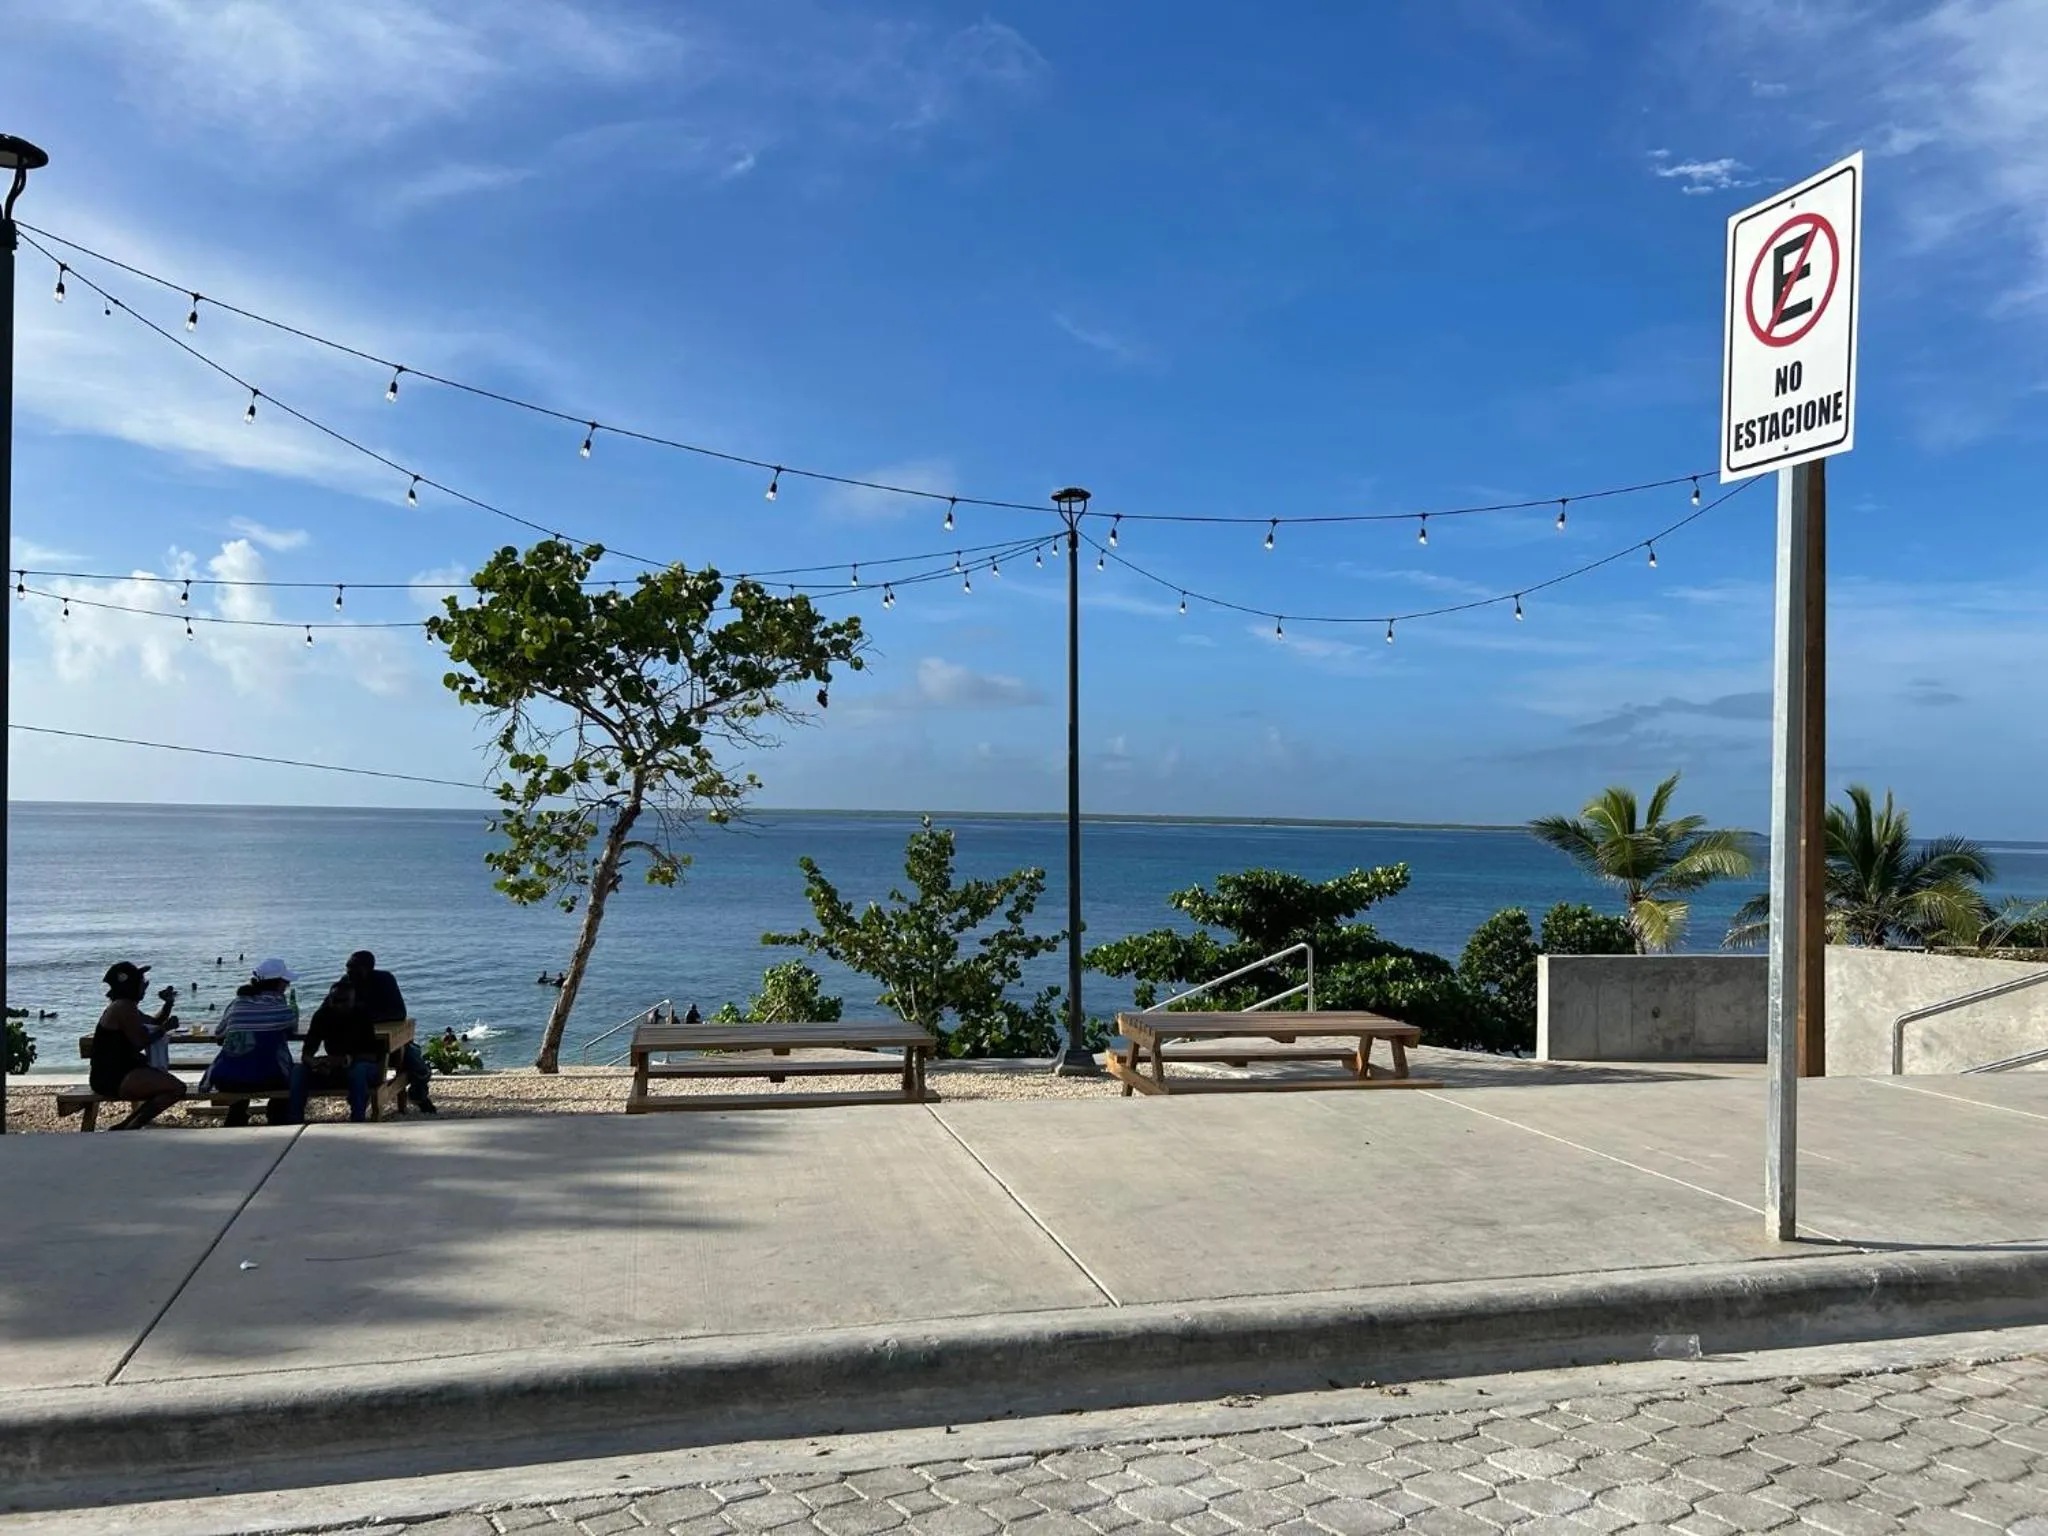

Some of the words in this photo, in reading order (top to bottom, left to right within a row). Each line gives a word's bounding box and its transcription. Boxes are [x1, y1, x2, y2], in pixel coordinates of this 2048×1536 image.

[1773, 230, 1813, 326] E
[1775, 361, 1802, 397] NO
[1734, 391, 1843, 452] ESTACIONE
